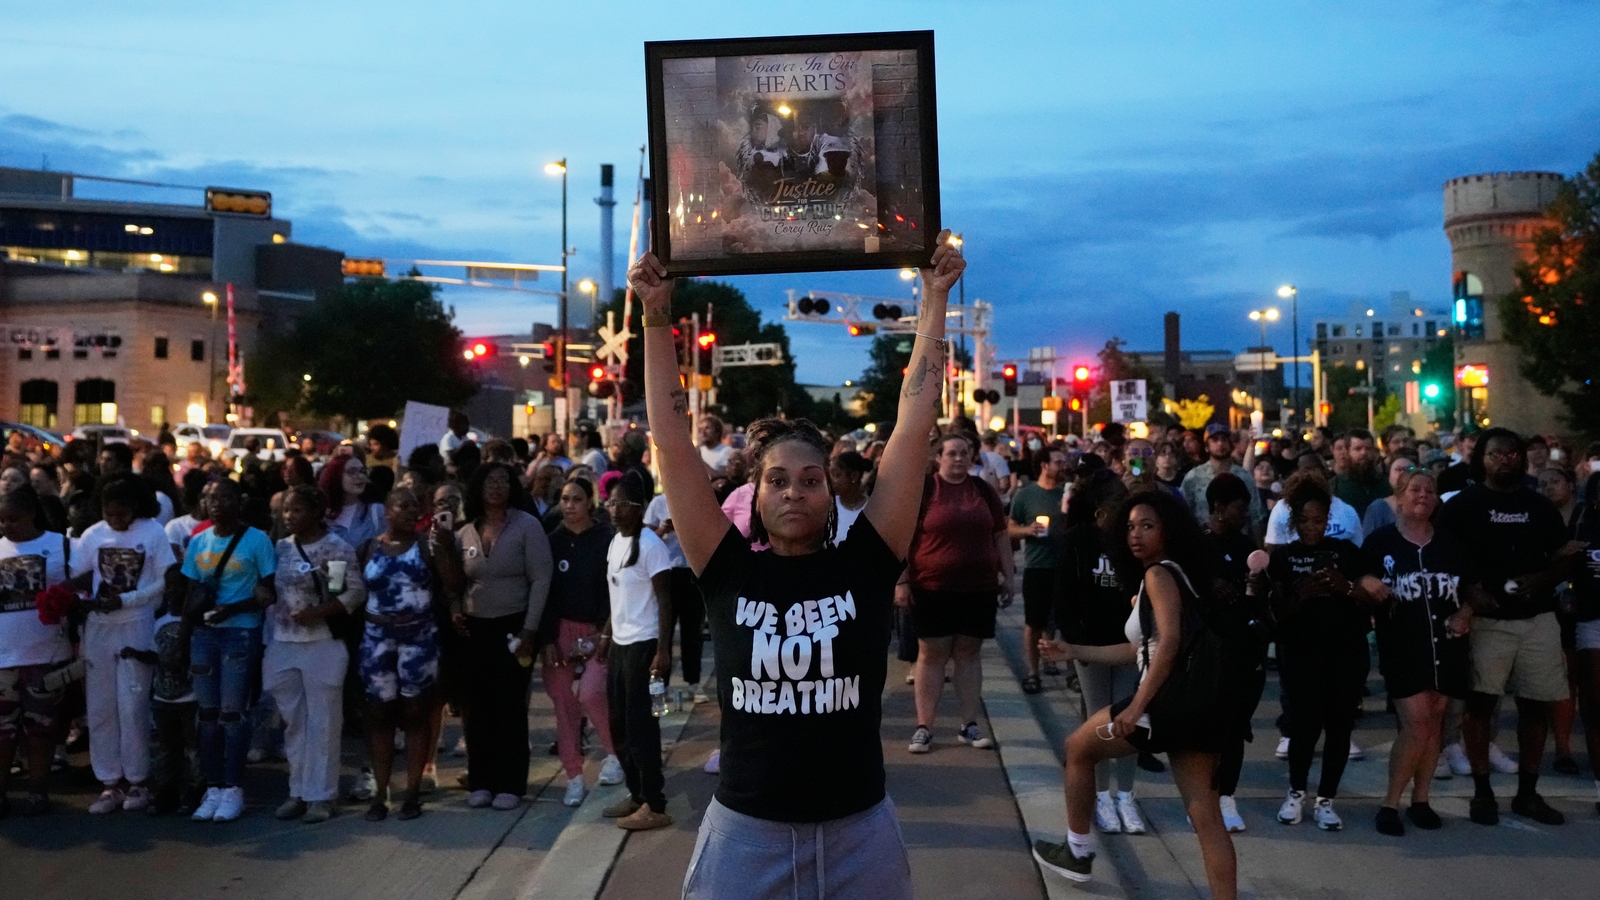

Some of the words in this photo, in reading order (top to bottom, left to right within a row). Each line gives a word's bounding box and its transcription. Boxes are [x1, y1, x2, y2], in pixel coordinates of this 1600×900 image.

[743, 57, 796, 74] Forever
[799, 54, 824, 72] In
[828, 54, 856, 71] Our
[755, 72, 846, 94] HEARTS
[768, 176, 838, 204] Justice
[775, 221, 806, 237] Corey
[807, 220, 834, 236] Ruiz
[735, 597, 779, 635] WE
[785, 590, 857, 637] BEEN
[750, 625, 840, 682] NOT
[731, 675, 860, 715] BREATHIN
